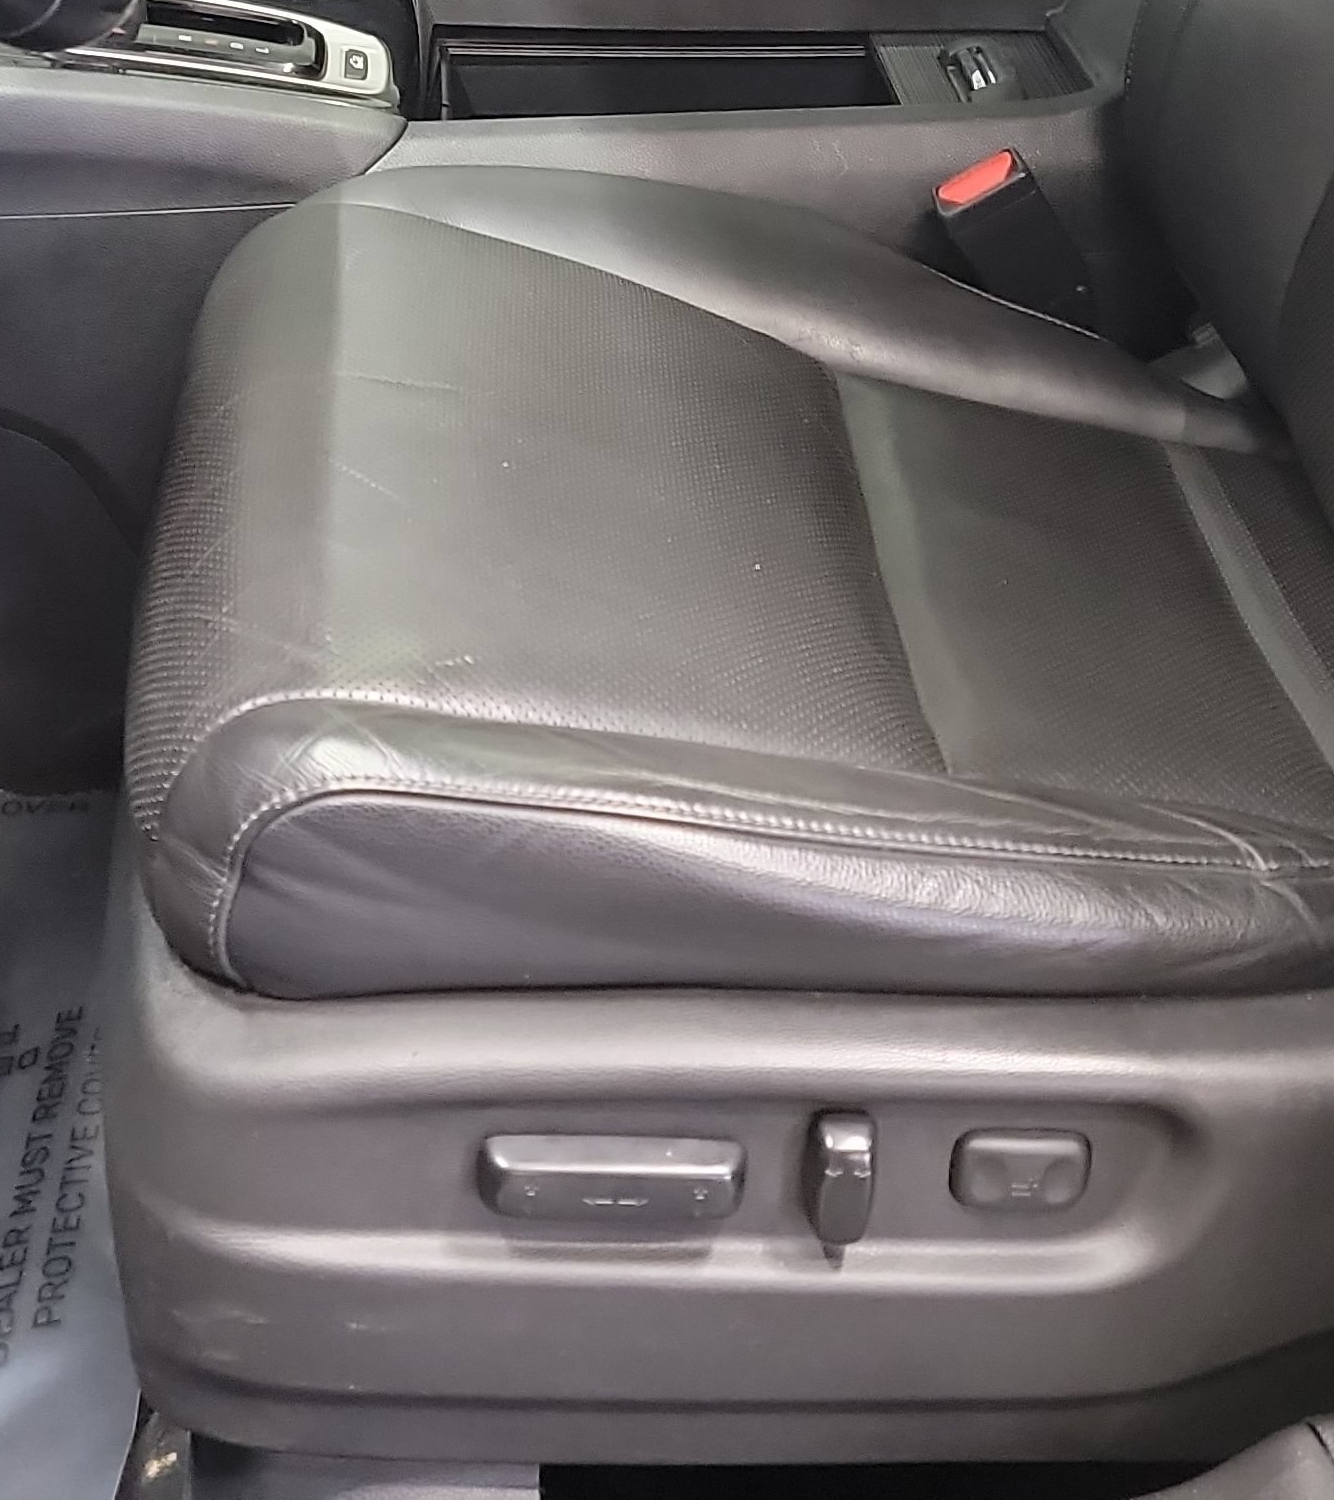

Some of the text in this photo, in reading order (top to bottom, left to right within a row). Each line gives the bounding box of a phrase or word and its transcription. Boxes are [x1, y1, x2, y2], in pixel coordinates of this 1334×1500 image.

[9, 1131, 53, 1218] MUST
[32, 1006, 83, 1123] REMOVE
[31, 1124, 100, 1329] PROTECTIVE
